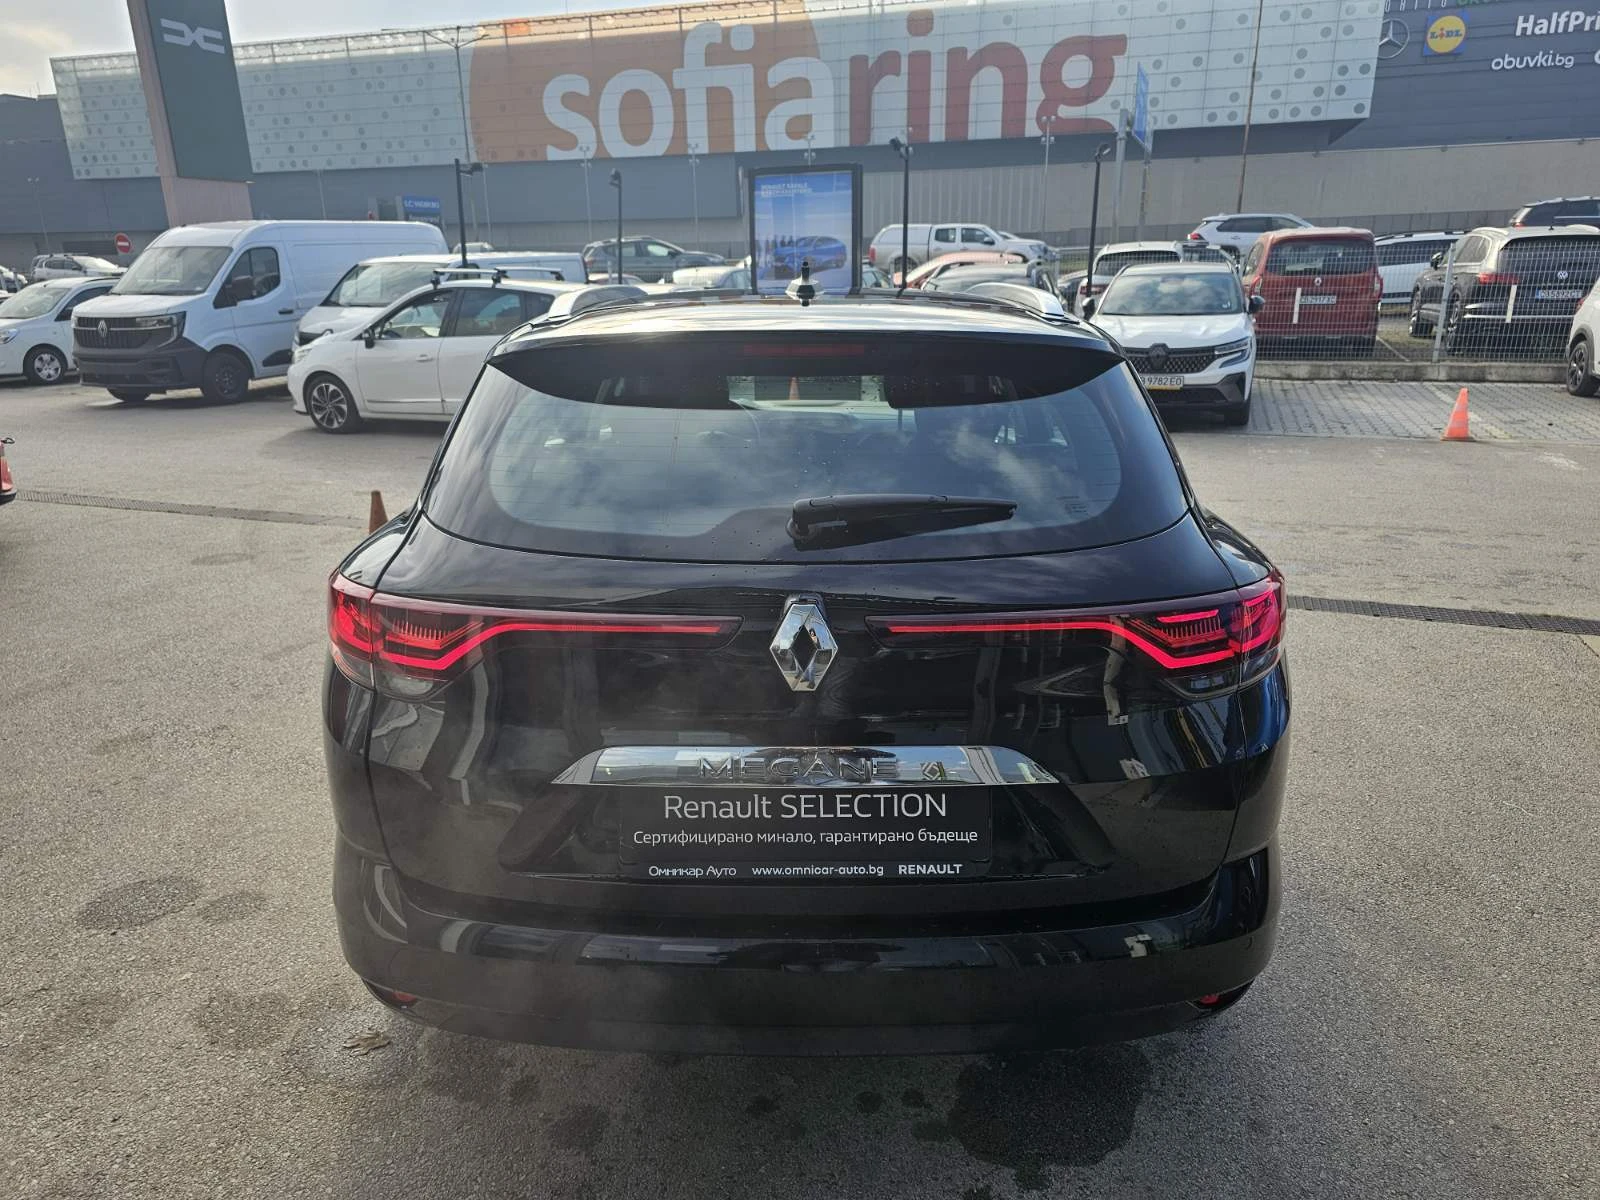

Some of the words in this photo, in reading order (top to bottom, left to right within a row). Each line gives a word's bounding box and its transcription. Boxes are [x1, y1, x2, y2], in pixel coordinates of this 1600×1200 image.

[1491, 51, 1575, 71] obuvki.bg
[543, 9, 1127, 160] sofiaring
[700, 757, 898, 778] MEGANE
[664, 794, 772, 819] Renault
[781, 793, 947, 818] SELECTION
[634, 829, 753, 847] Сертифицирано
[757, 831, 816, 845] минало,
[820, 831, 914, 845] гарантирано
[918, 828, 978, 844] бъдеще
[648, 865, 704, 879] Омникар
[706, 865, 737, 879] Ауто
[752, 864, 884, 877] www.omnicar-auto.bg
[898, 864, 963, 875] RENAULT
